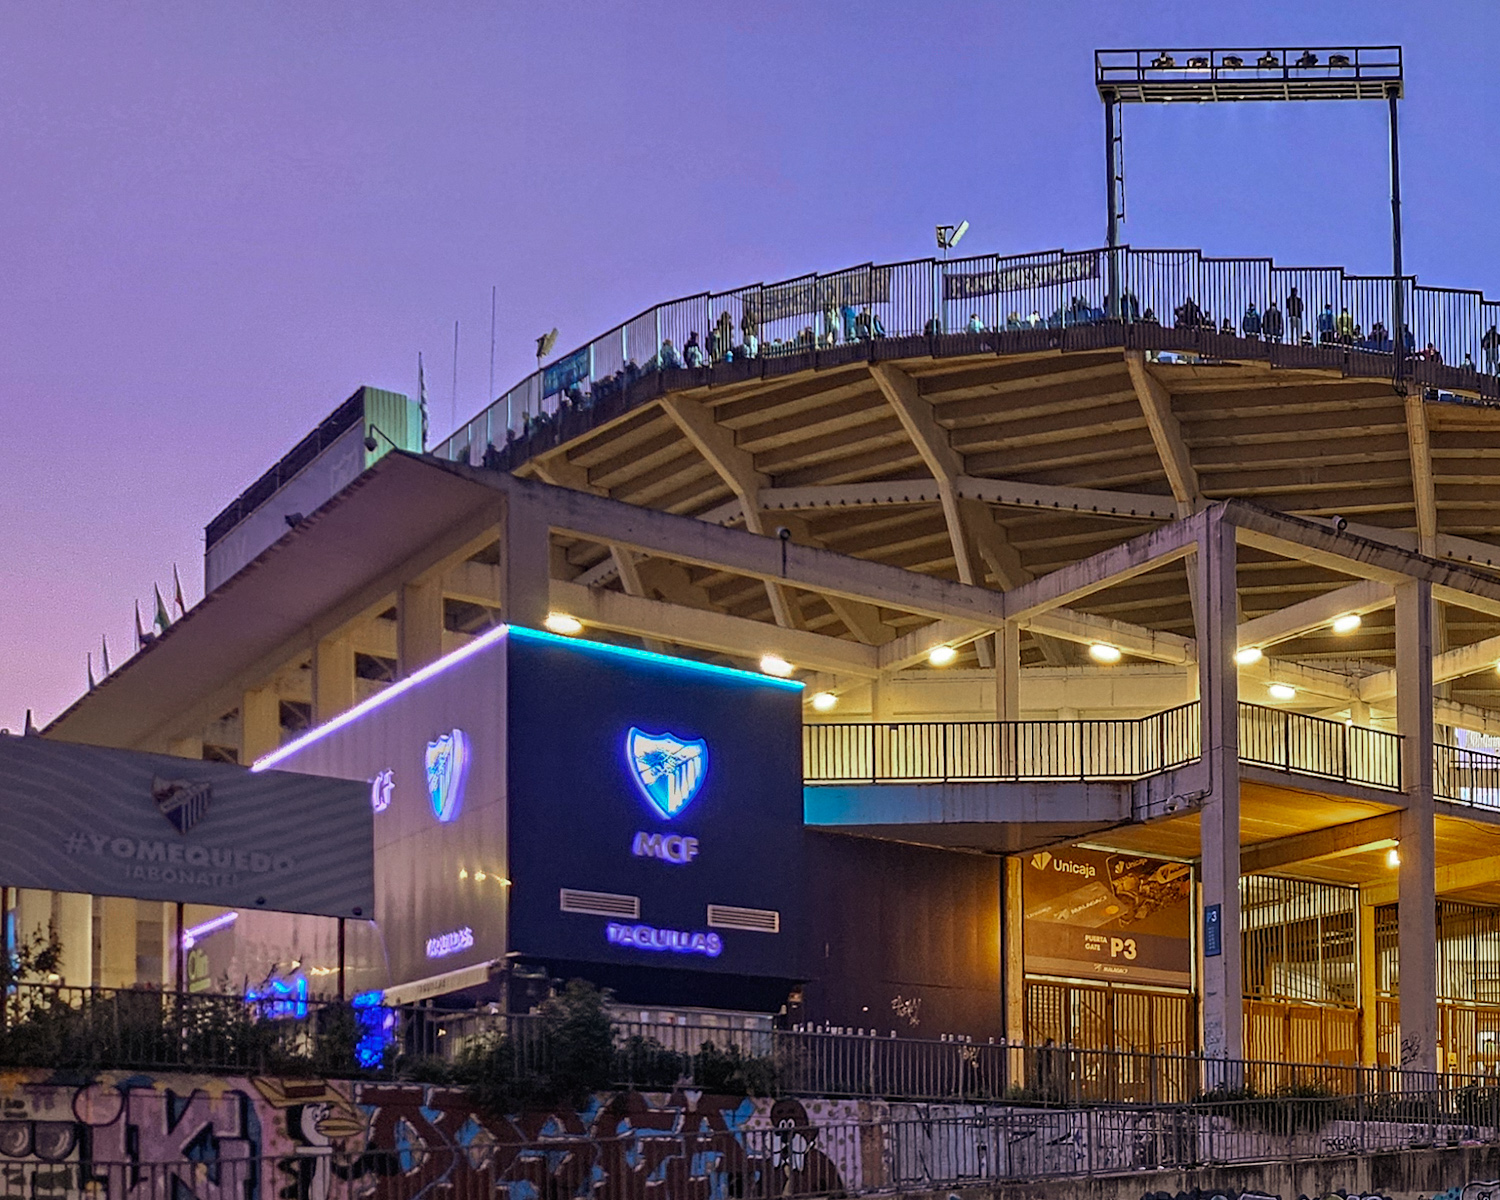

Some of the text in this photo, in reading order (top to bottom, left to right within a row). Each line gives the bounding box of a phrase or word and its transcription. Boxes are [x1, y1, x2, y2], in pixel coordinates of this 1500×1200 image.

[65, 831, 295, 873] #YOMEQUEDO
[632, 831, 700, 864] MCF
[1053, 858, 1096, 878] Unicaja
[607, 922, 722, 957] TAQUILLAS
[1084, 934, 1108, 944] PUERTA
[1084, 943, 1101, 951] GATE
[1110, 937, 1137, 960] P3
